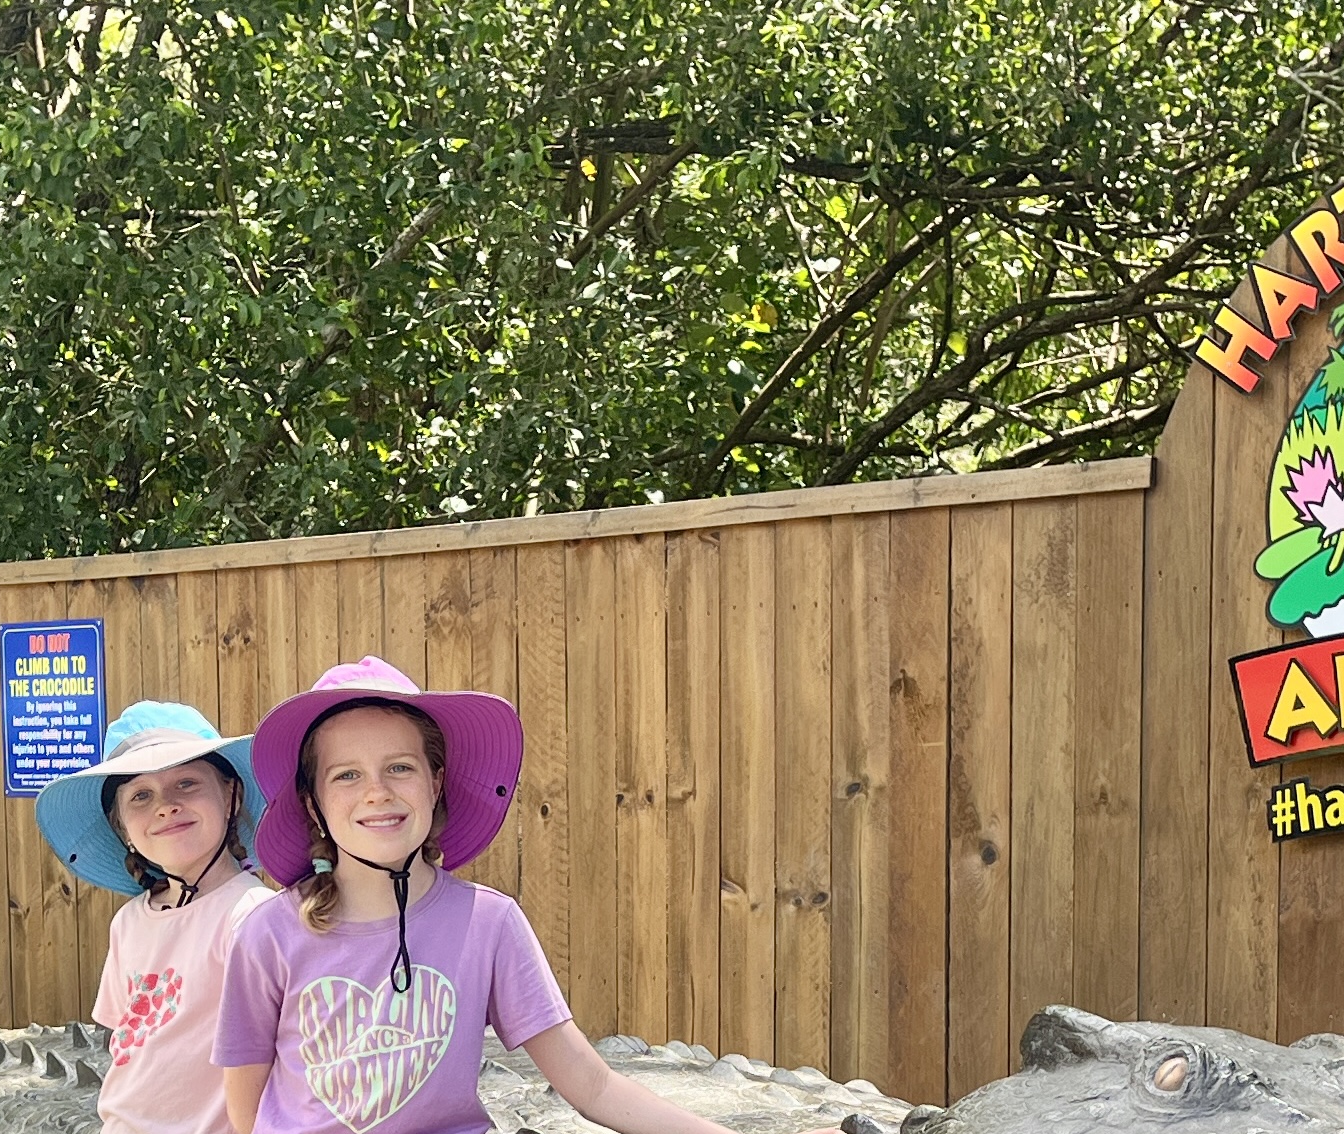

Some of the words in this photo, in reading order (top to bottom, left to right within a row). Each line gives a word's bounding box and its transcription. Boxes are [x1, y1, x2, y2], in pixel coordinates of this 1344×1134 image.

[29, 635, 45, 654] DO
[47, 633, 70, 653] NOT
[16, 657, 50, 676] CLIMB
[53, 656, 68, 675] ON
[71, 655, 86, 674] TO
[9, 679, 30, 697] THE
[32, 677, 94, 696] CROCODILE
[26, 701, 35, 714] By
[64, 700, 76, 711] this
[50, 716, 62, 728] you
[63, 714, 78, 725] take
[37, 743, 45, 754] to
[46, 744, 58, 756] you
[73, 743, 95, 754] others
[36, 758, 50, 770] your
